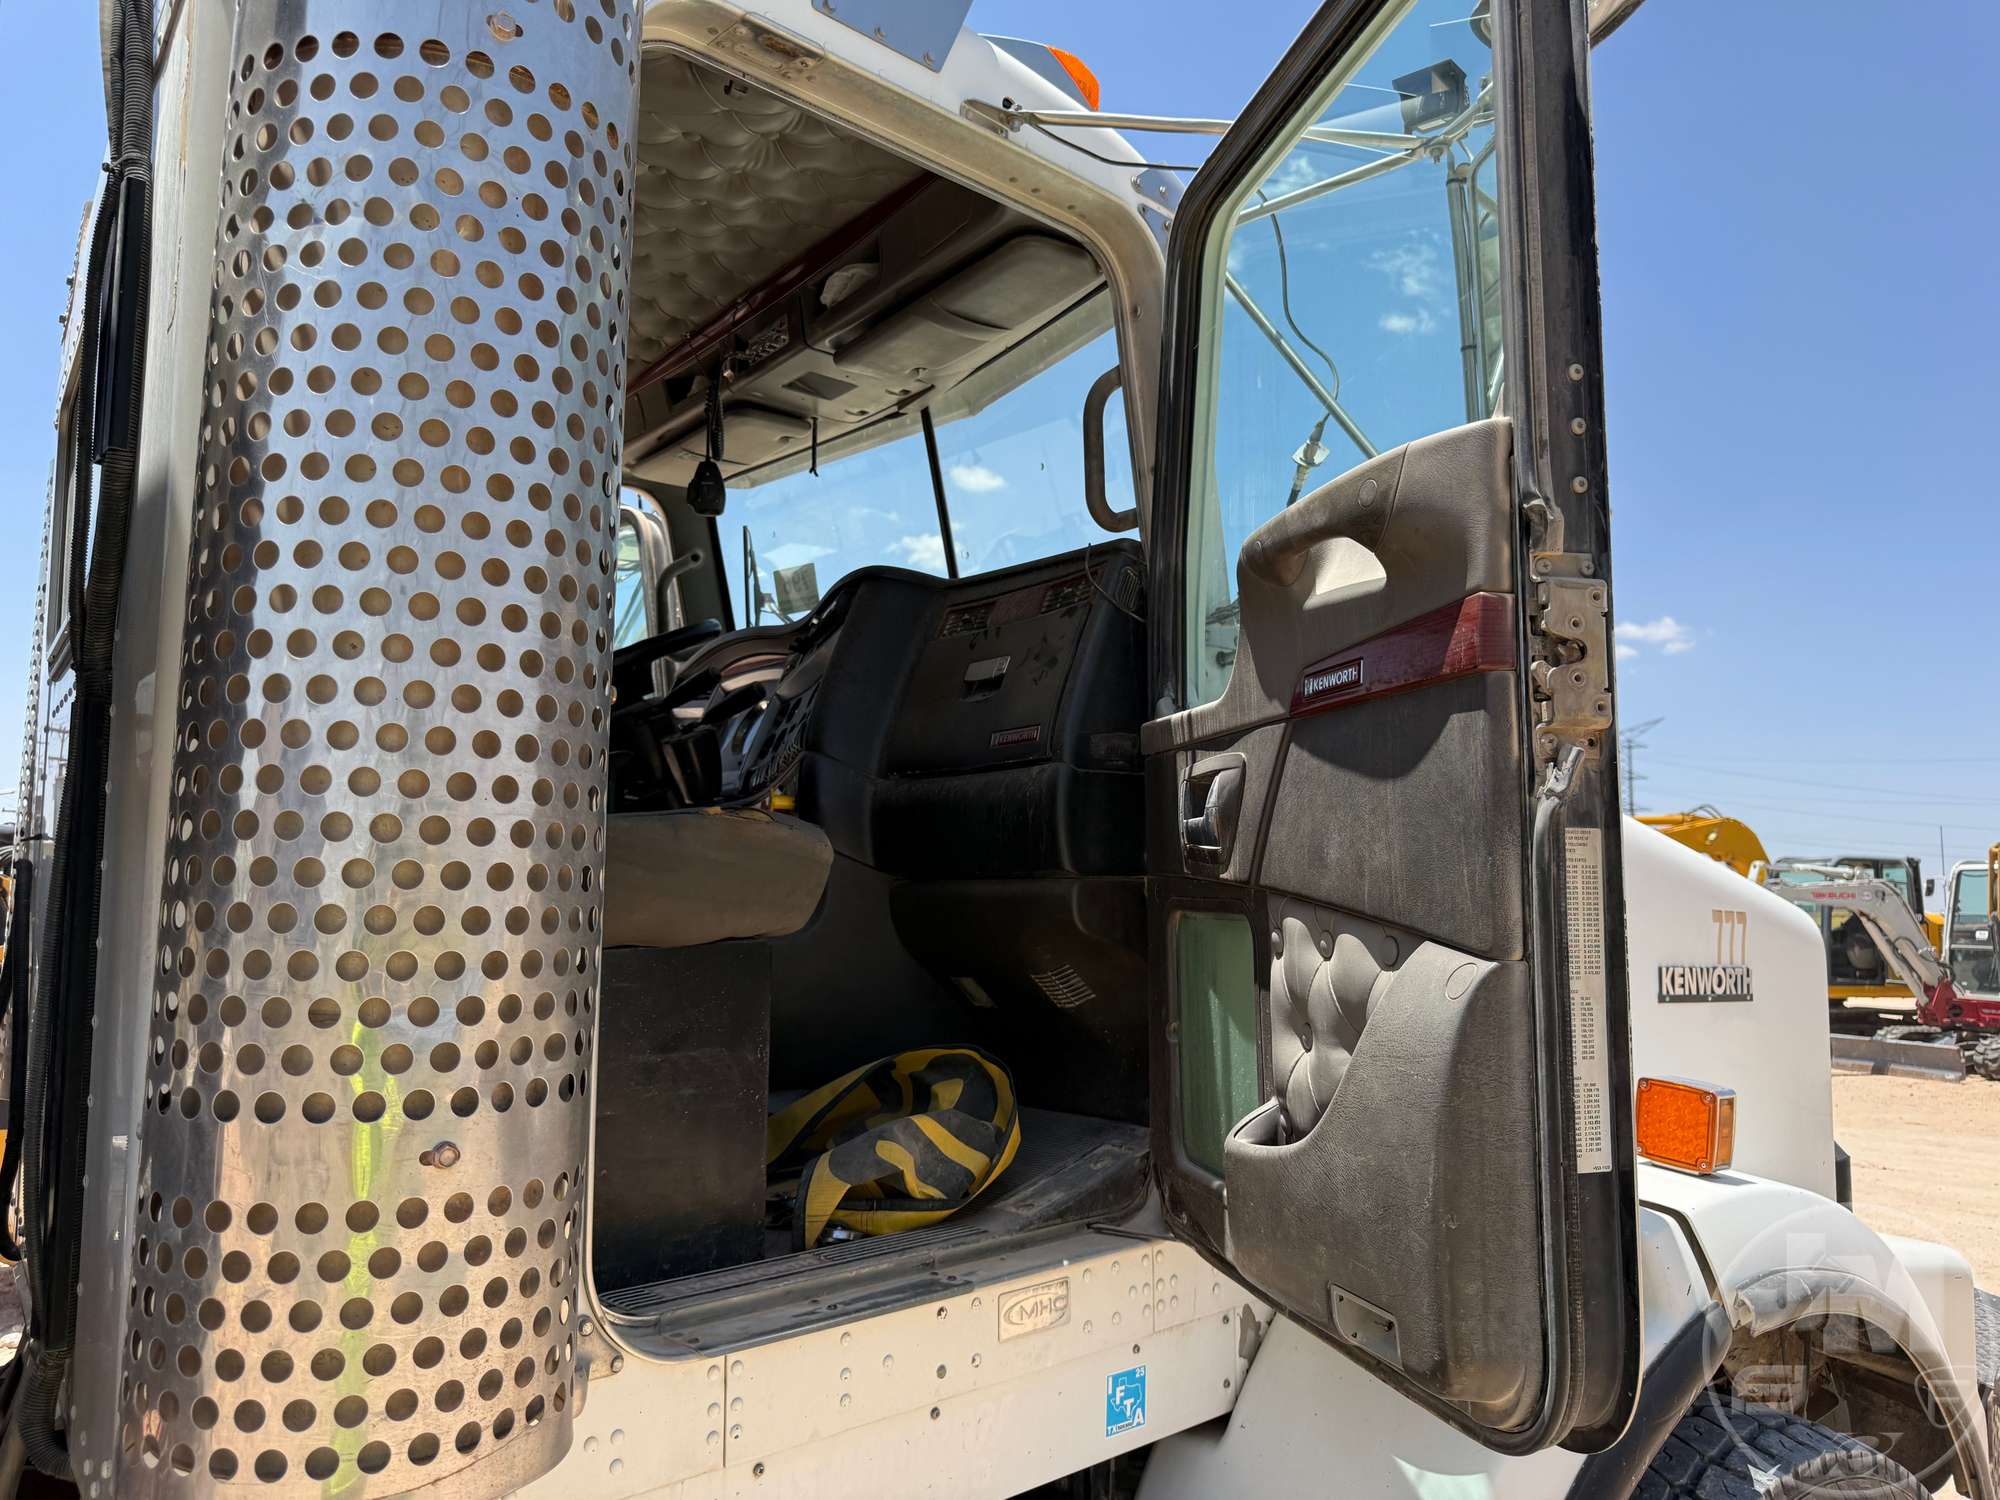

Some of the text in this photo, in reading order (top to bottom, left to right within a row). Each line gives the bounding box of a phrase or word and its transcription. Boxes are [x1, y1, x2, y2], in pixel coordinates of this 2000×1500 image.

[1313, 666, 1358, 693] KENWORTH
[1711, 908, 1747, 965] 777
[1660, 965, 1753, 996] KENWORTH
